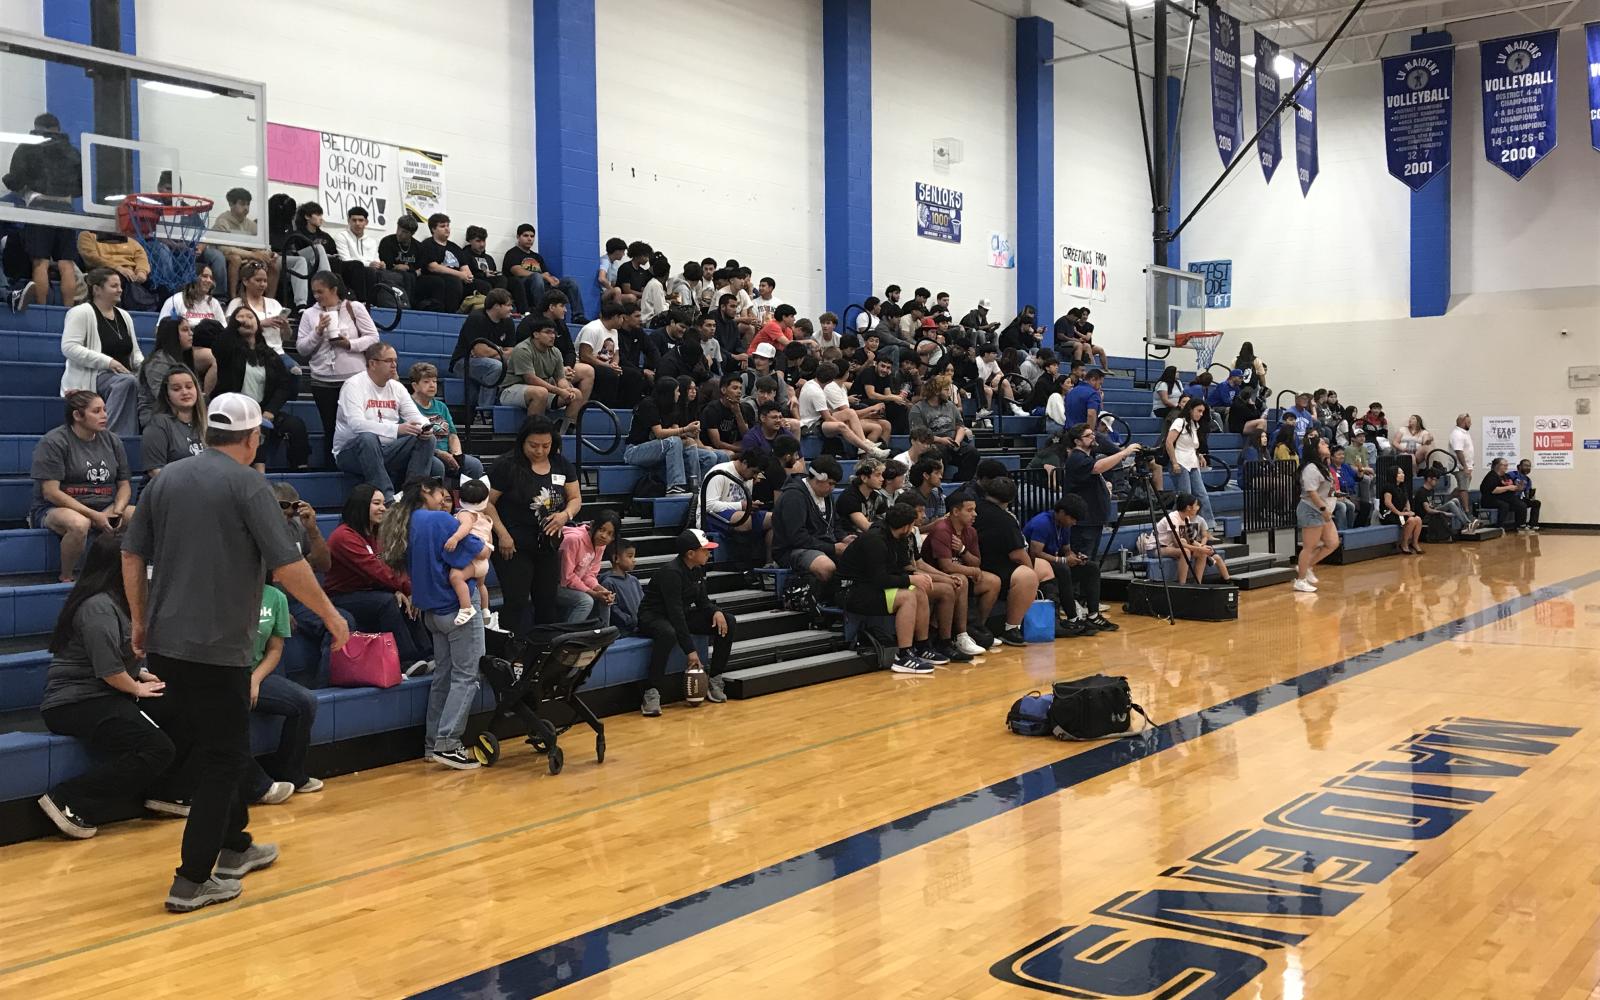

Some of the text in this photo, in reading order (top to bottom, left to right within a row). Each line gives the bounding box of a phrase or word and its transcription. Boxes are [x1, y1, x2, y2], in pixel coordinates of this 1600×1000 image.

[1214, 47, 1236, 69] SOCCER
[1505, 40, 1542, 59] MAIDENS
[1404, 57, 1440, 76] MAIDENS
[1485, 70, 1553, 92] VOLLEYBALL
[1386, 87, 1450, 108] VOLLEYBALL
[1495, 91, 1523, 101] DISTRICT
[1500, 96, 1537, 107] CHAMPIONS
[1500, 112, 1537, 124] CHAMPIONS
[1509, 121, 1546, 132] CHAMPIONS
[321, 132, 381, 160] BE LOUD
[1501, 145, 1536, 163] 2000
[328, 153, 347, 173] OR
[364, 162, 387, 183] SIT
[1404, 160, 1433, 177] 2001
[326, 172, 356, 192] with
[919, 183, 961, 209] SENIORS
[325, 190, 387, 227] MOM!
[932, 211, 949, 228] 1000
[1063, 246, 1108, 267] GREETINGS FROM
[1535, 435, 1550, 448] NO
[988, 715, 1582, 1000] MAIDENS
